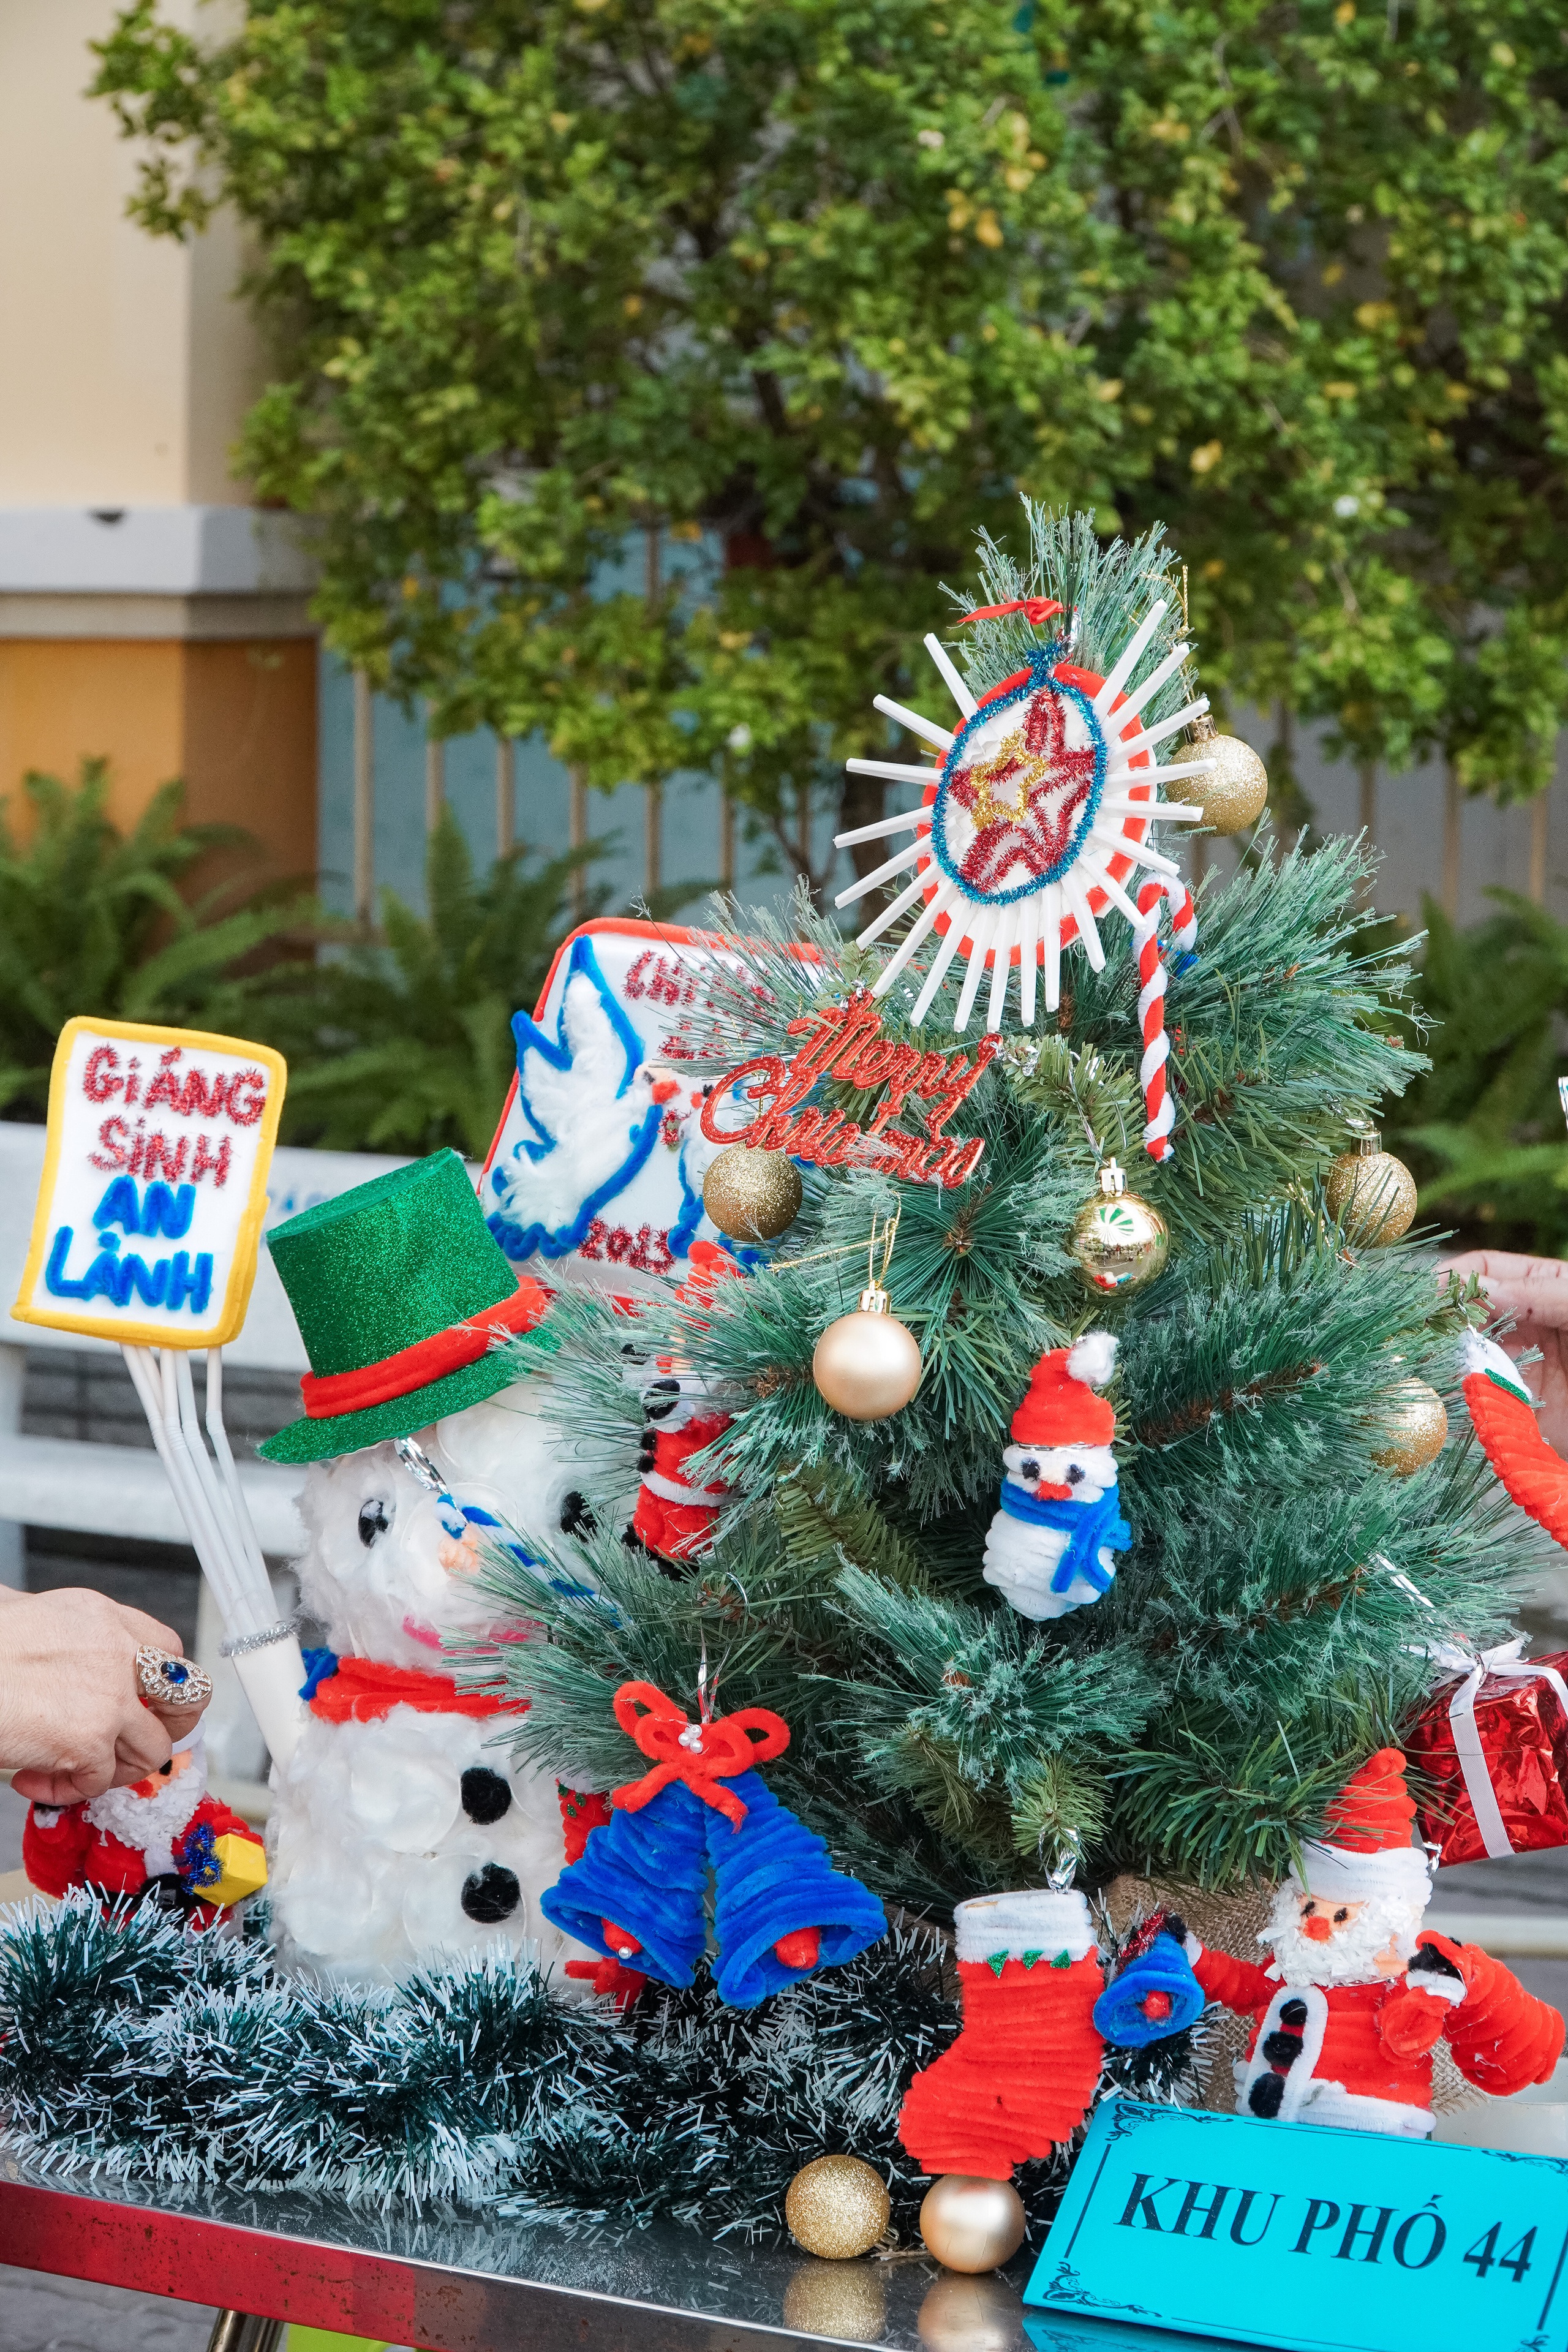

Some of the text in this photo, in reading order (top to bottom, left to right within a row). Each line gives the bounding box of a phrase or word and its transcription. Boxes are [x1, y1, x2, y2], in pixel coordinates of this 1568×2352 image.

[786, 1007, 1004, 1130] Merry
[92, 1174, 197, 1239] AN
[1112, 2172, 1539, 2284] KHU PHỐ 44
